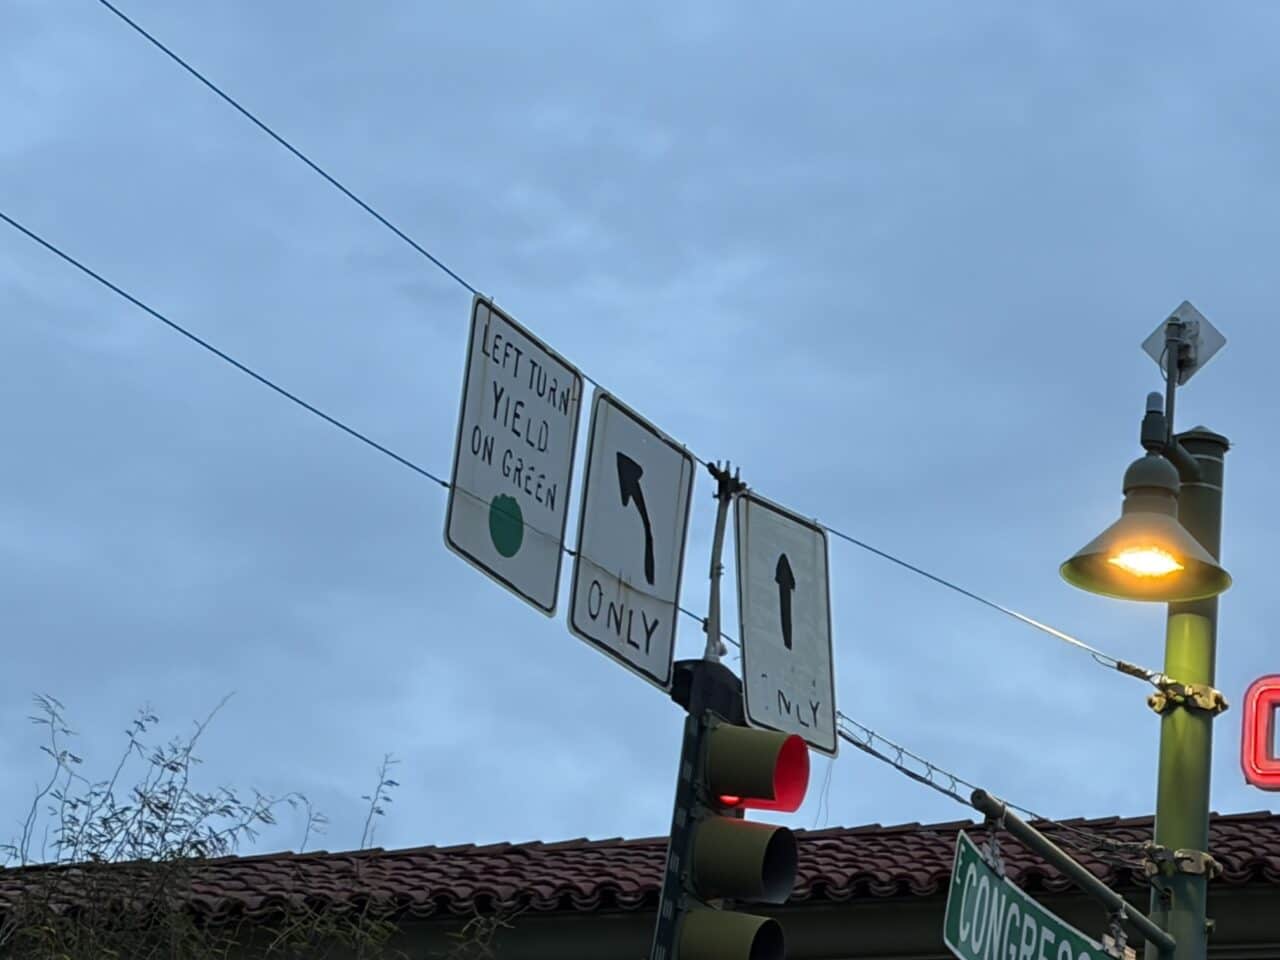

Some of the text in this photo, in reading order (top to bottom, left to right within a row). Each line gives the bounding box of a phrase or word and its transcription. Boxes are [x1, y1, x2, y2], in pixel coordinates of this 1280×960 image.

[482, 323, 570, 417] LEFT TURN
[492, 380, 549, 453] YIELD
[471, 425, 559, 512] ON GREEN
[587, 579, 659, 656] ONLY
